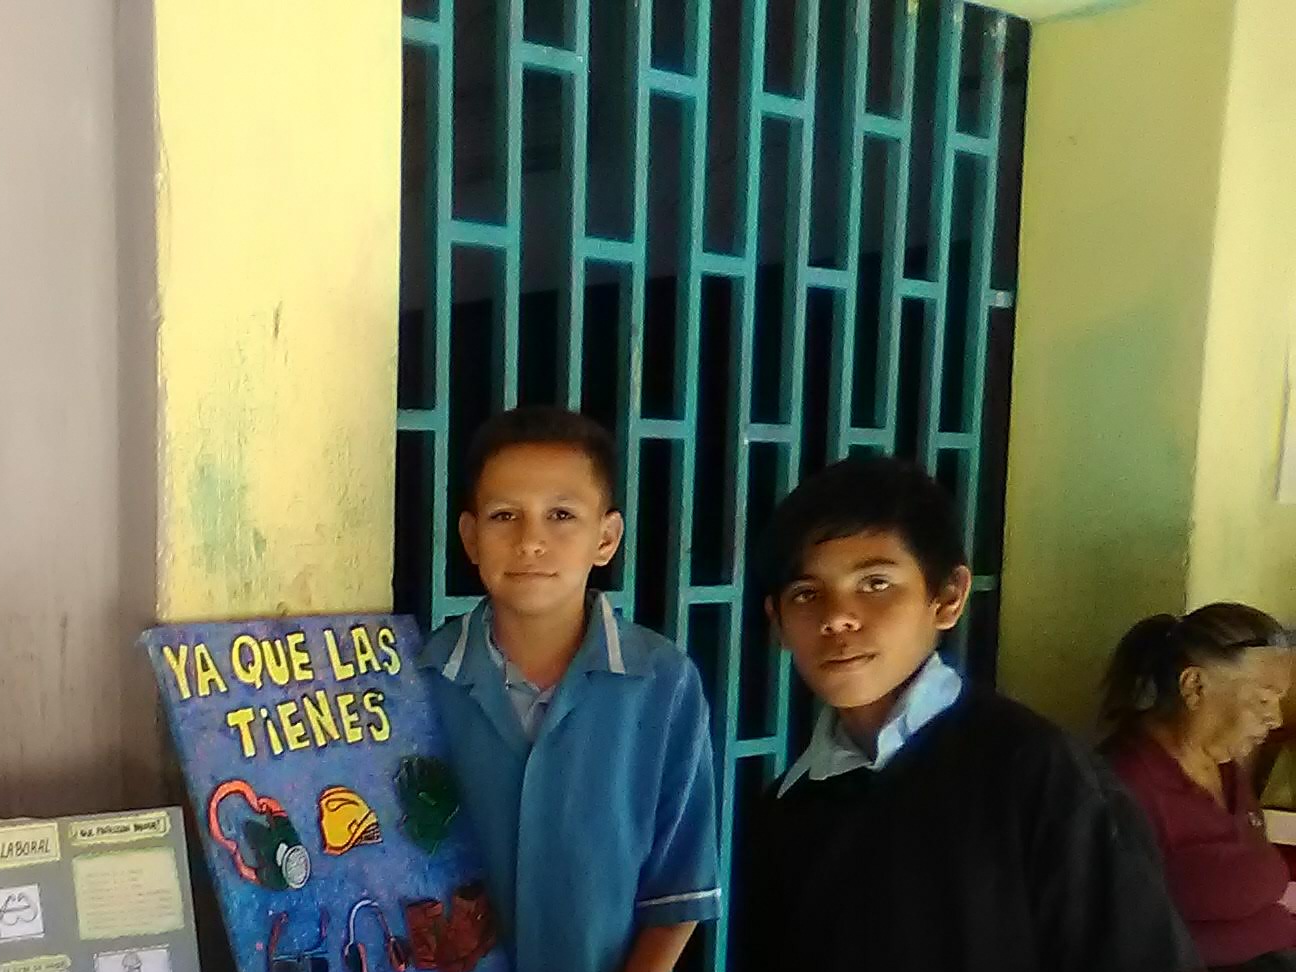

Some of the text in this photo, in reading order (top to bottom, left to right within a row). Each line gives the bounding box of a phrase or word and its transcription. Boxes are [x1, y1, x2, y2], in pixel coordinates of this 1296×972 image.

[162, 624, 401, 699] YA QUE LAS
[0, 838, 51, 859] LABORAL
